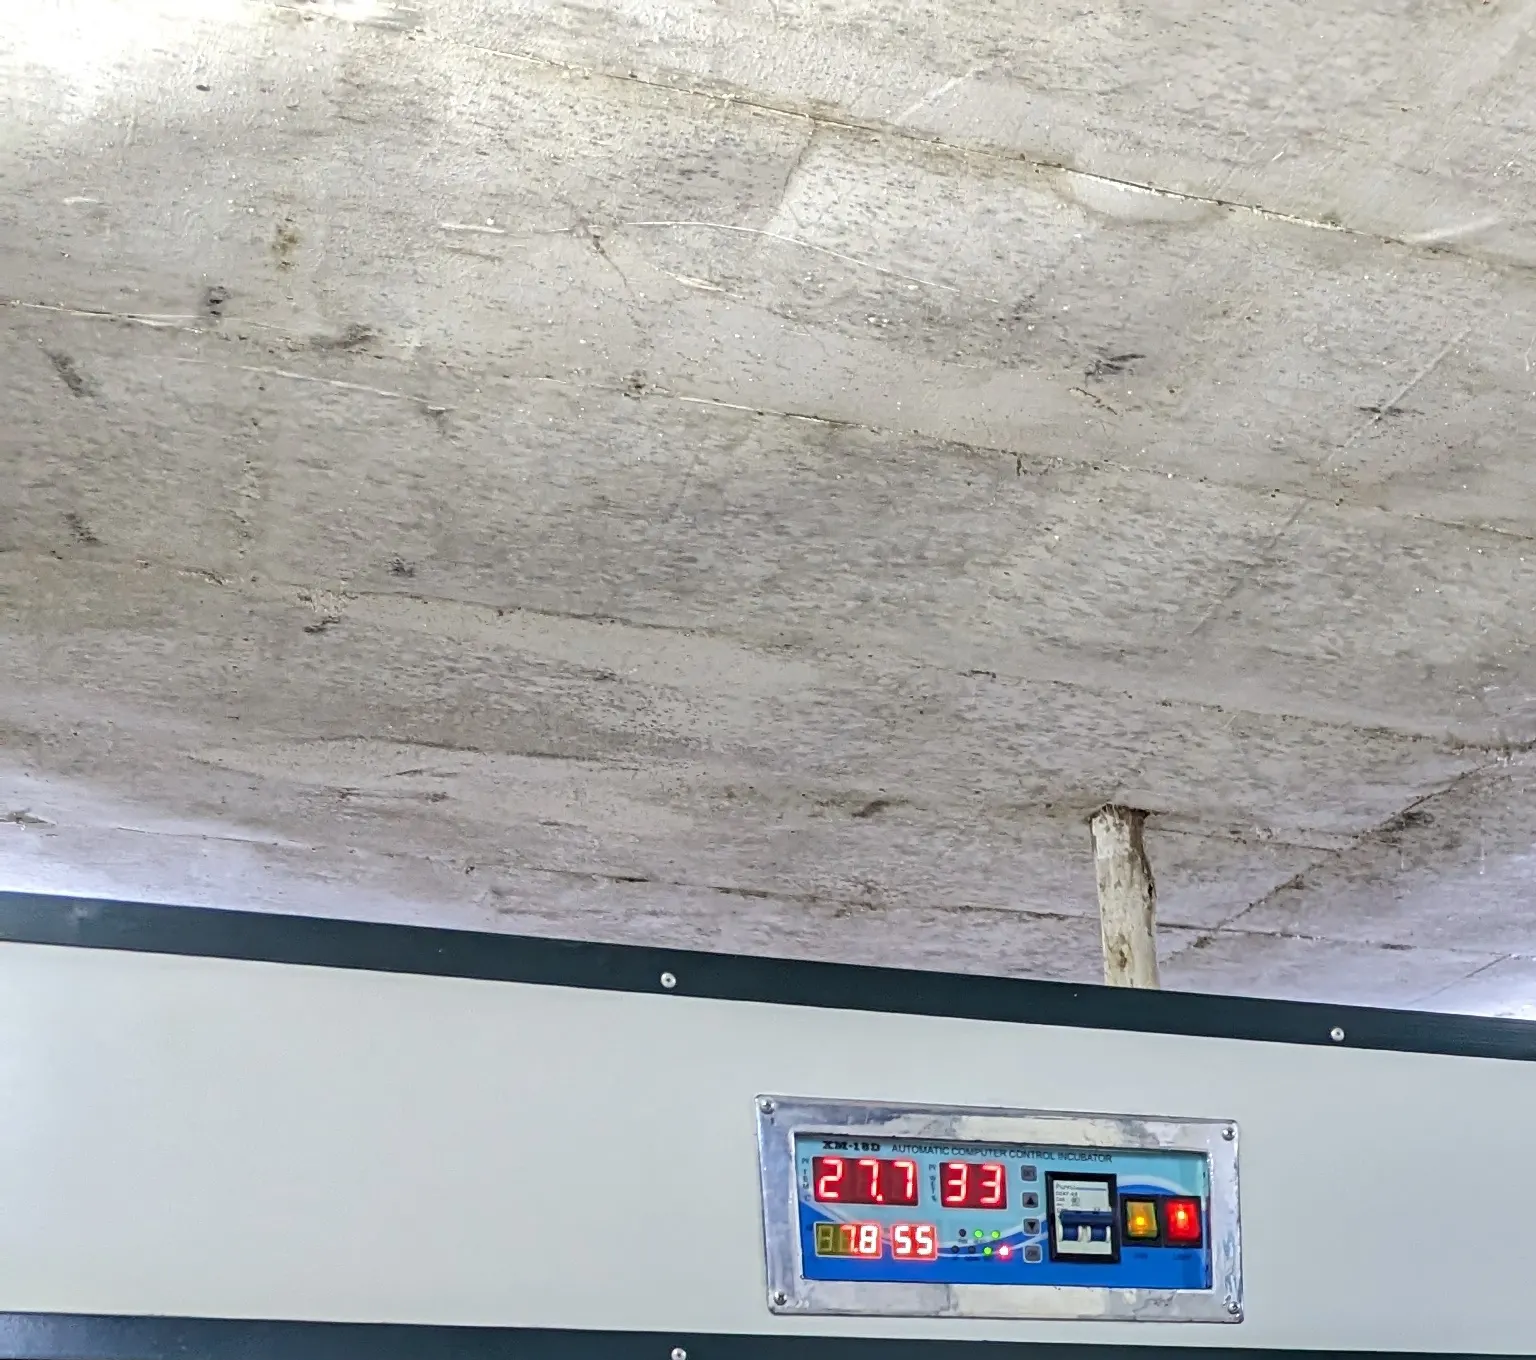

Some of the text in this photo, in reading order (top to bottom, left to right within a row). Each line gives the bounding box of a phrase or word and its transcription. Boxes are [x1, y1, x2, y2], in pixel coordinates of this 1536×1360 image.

[891, 1144, 1113, 1163] AUTOMATIC COMPUTER CONTROL INCUBATOR
[818, 1158, 914, 1202] 27.7
[945, 1163, 1002, 1204] 33
[893, 1225, 934, 1256] 55
